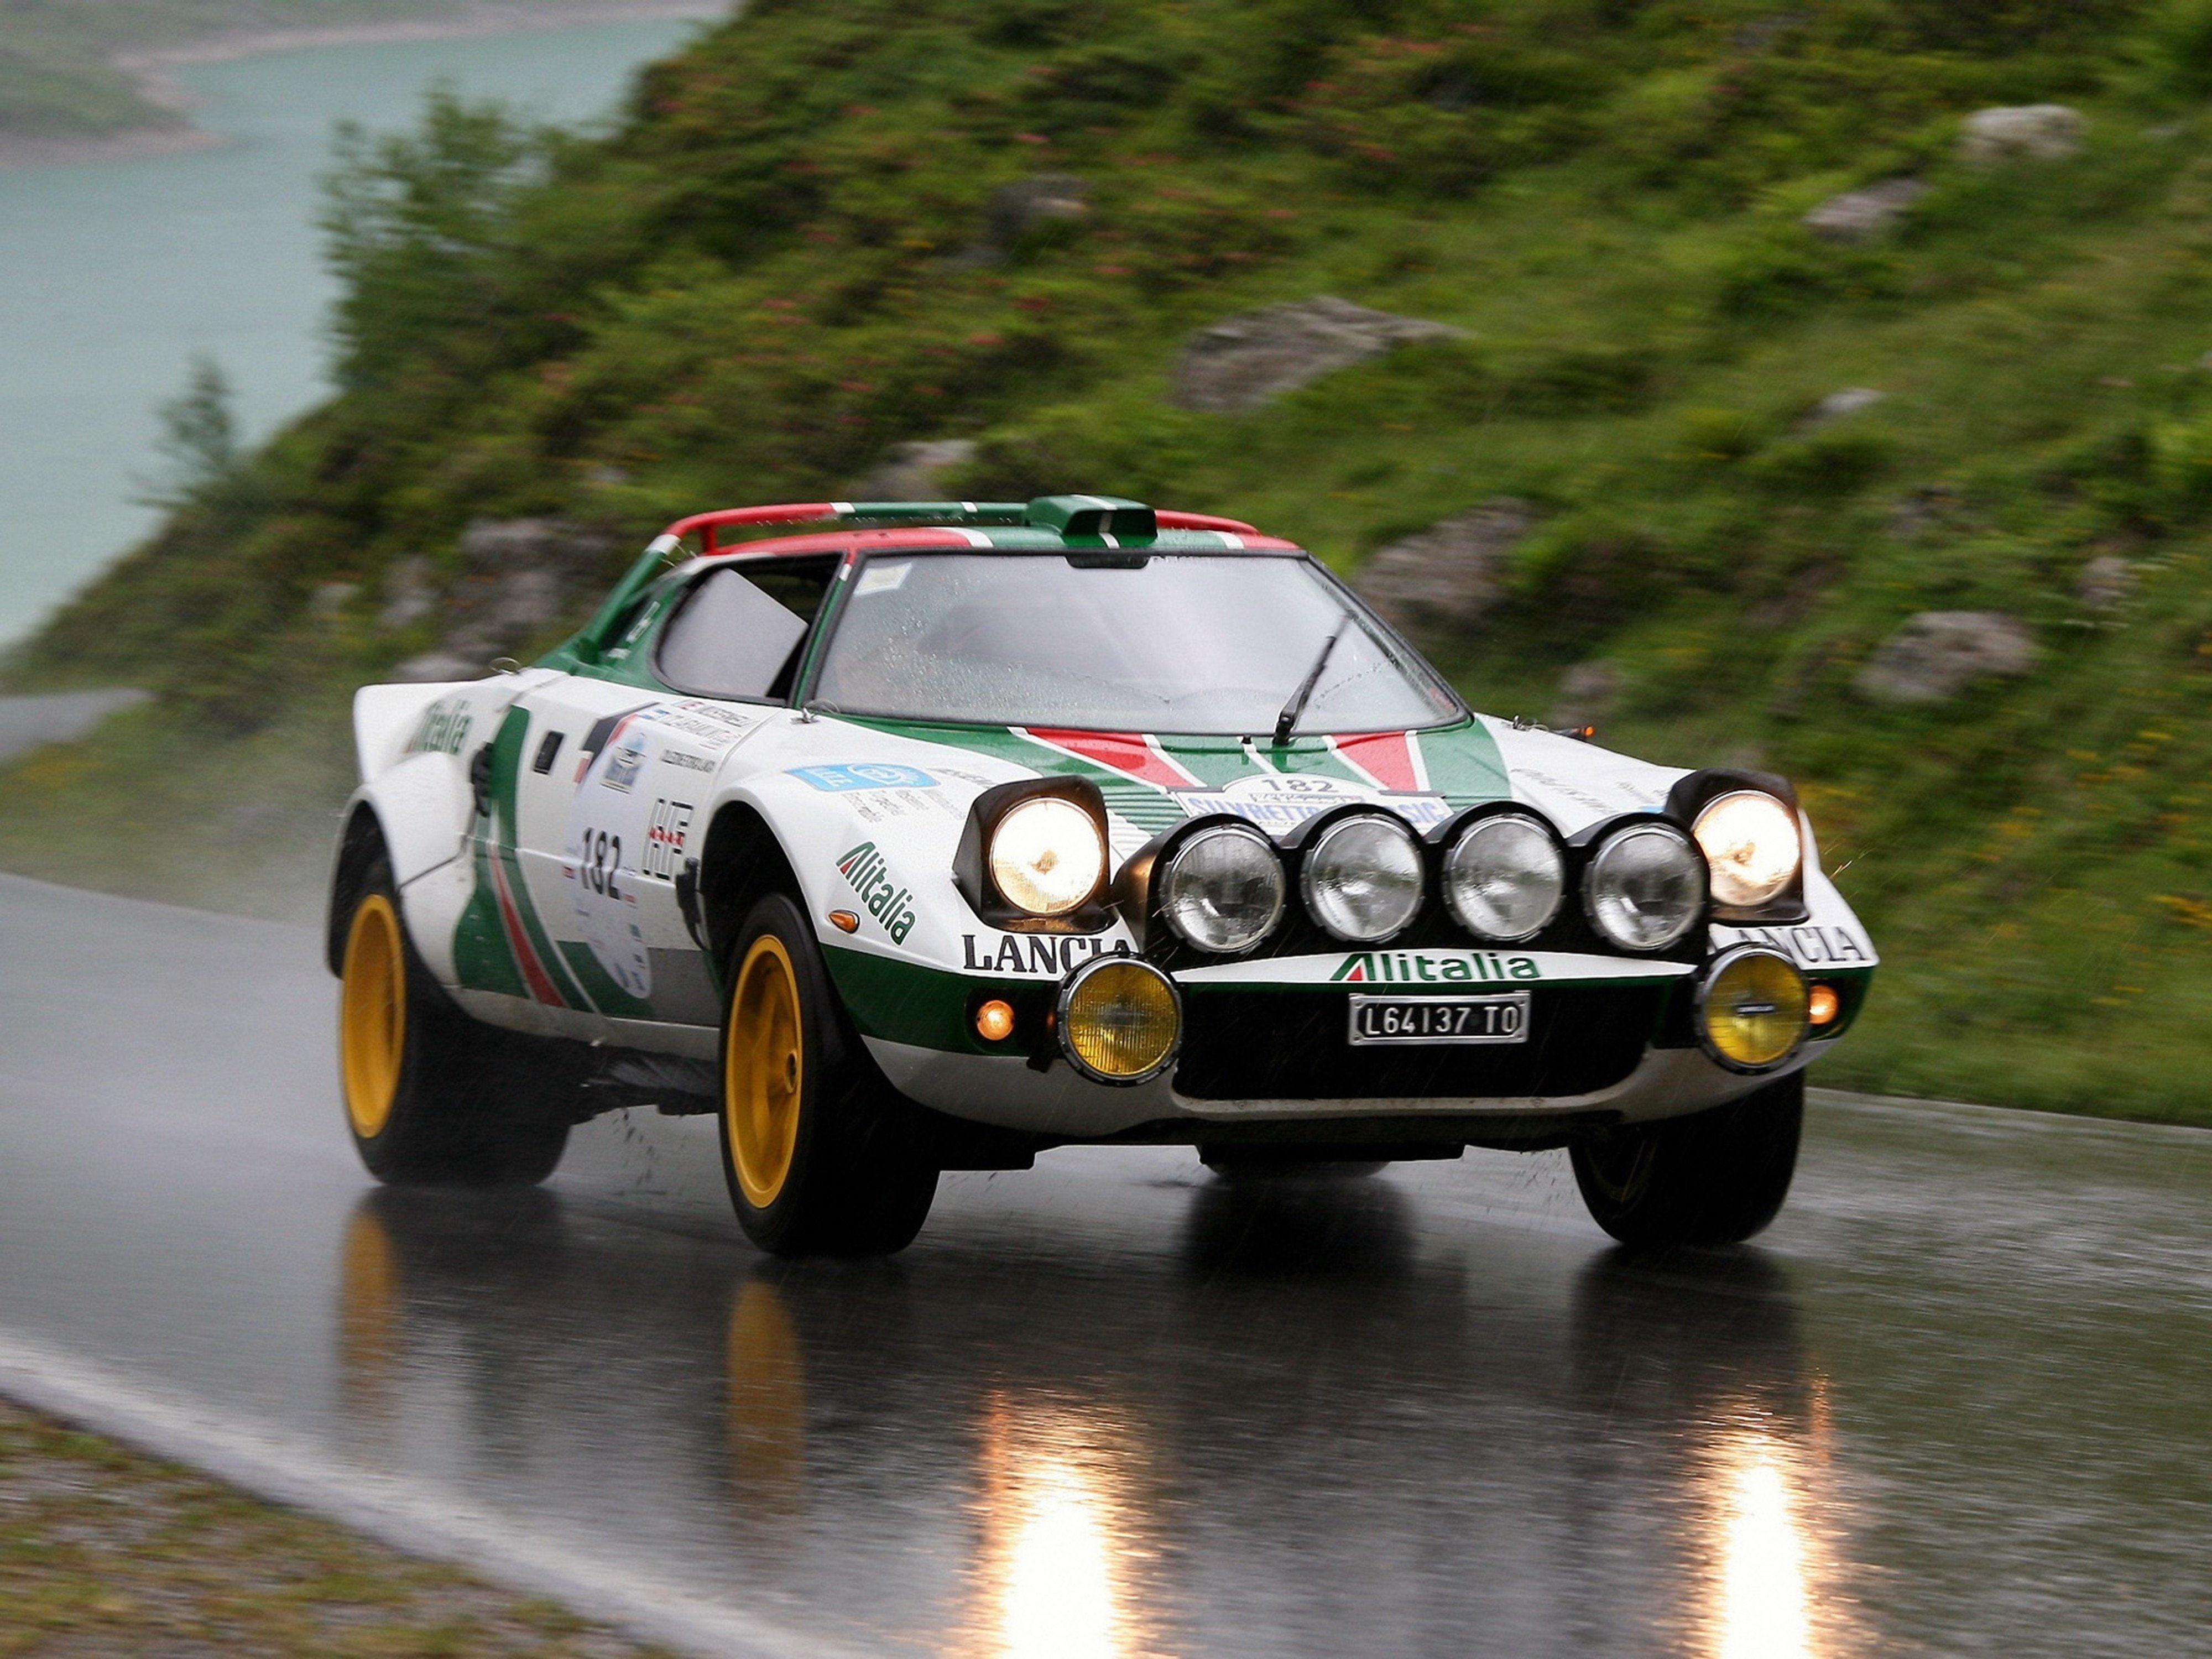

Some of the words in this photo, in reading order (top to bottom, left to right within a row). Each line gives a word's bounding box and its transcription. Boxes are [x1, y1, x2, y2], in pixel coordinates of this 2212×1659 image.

[1261, 778, 1339, 793] 182
[582, 827, 622, 900] 182
[836, 841, 915, 946] Alitalia
[1329, 952, 1541, 981] Alitalia
[1365, 1007, 1471, 1035] L64137
